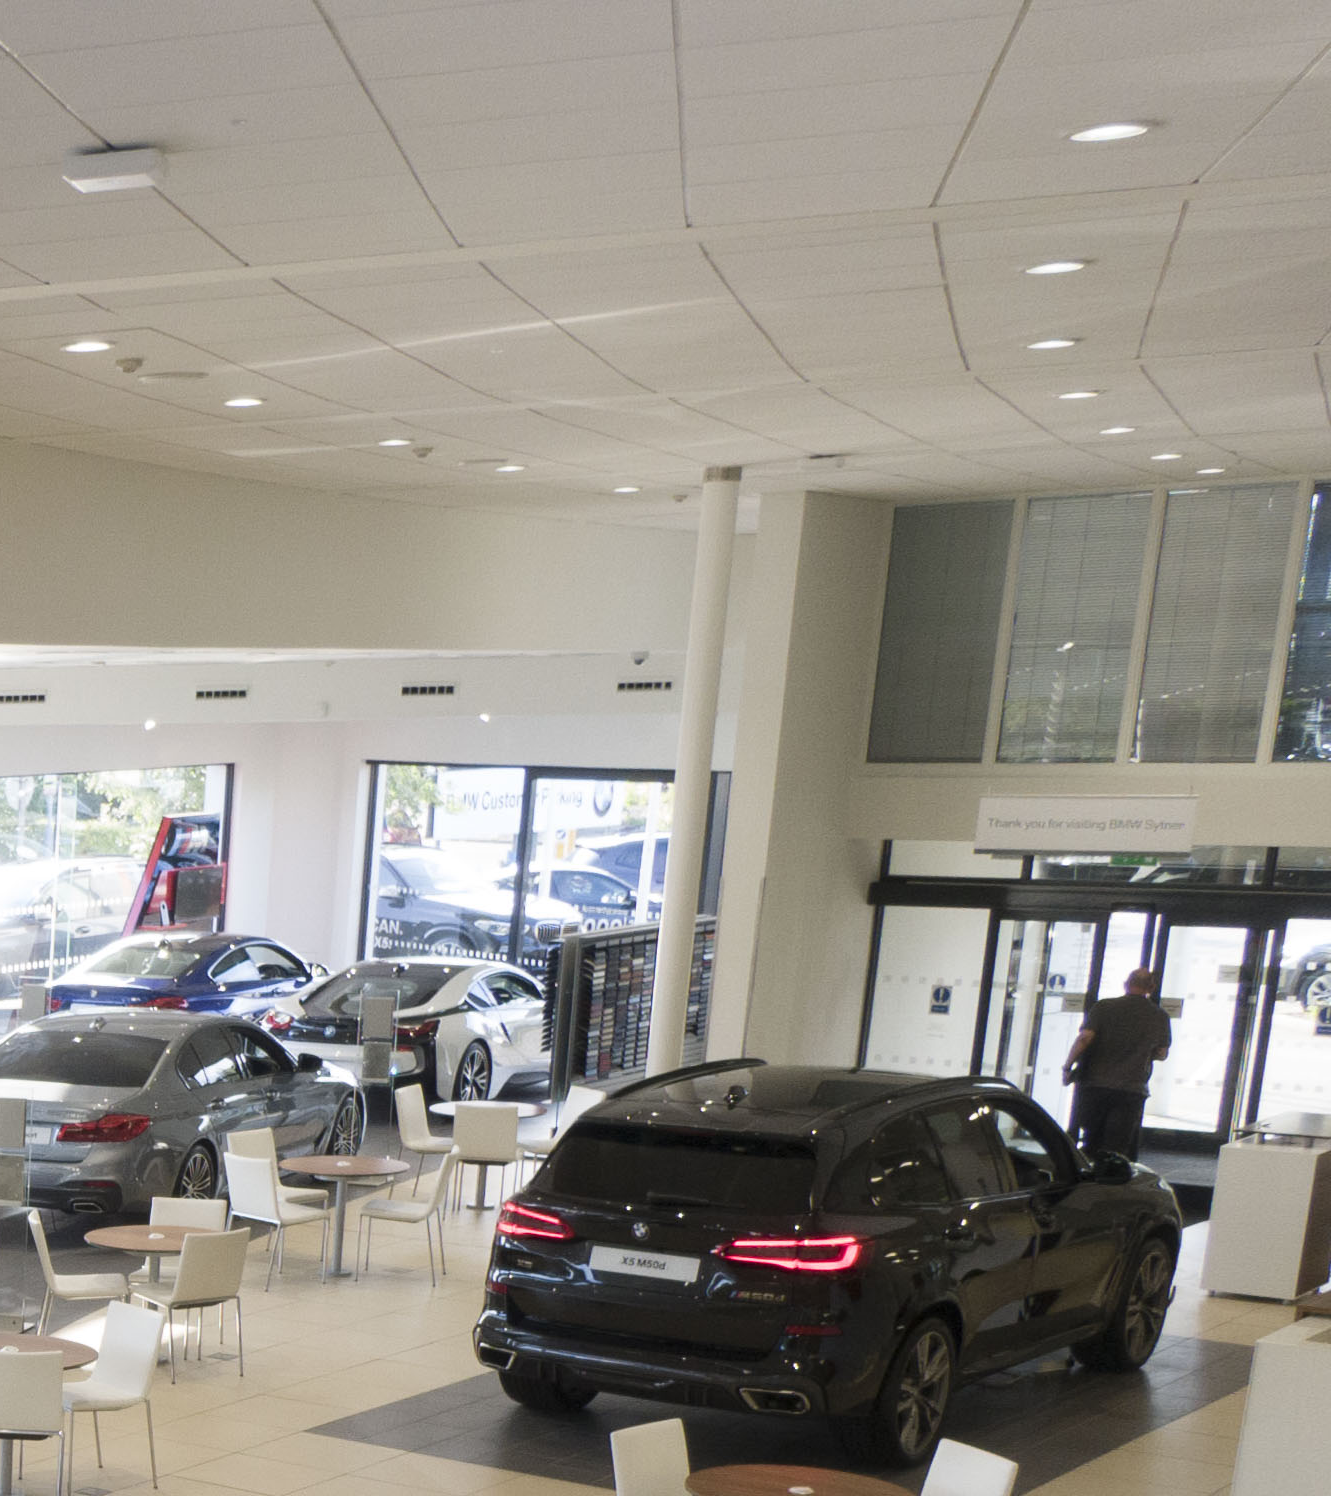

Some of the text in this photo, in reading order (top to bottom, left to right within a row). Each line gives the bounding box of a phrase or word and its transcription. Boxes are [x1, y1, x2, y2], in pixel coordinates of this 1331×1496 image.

[988, 817, 1186, 832] Thank you for visiting BMW Sytner
[621, 1255, 667, 1270] X5 M50d
